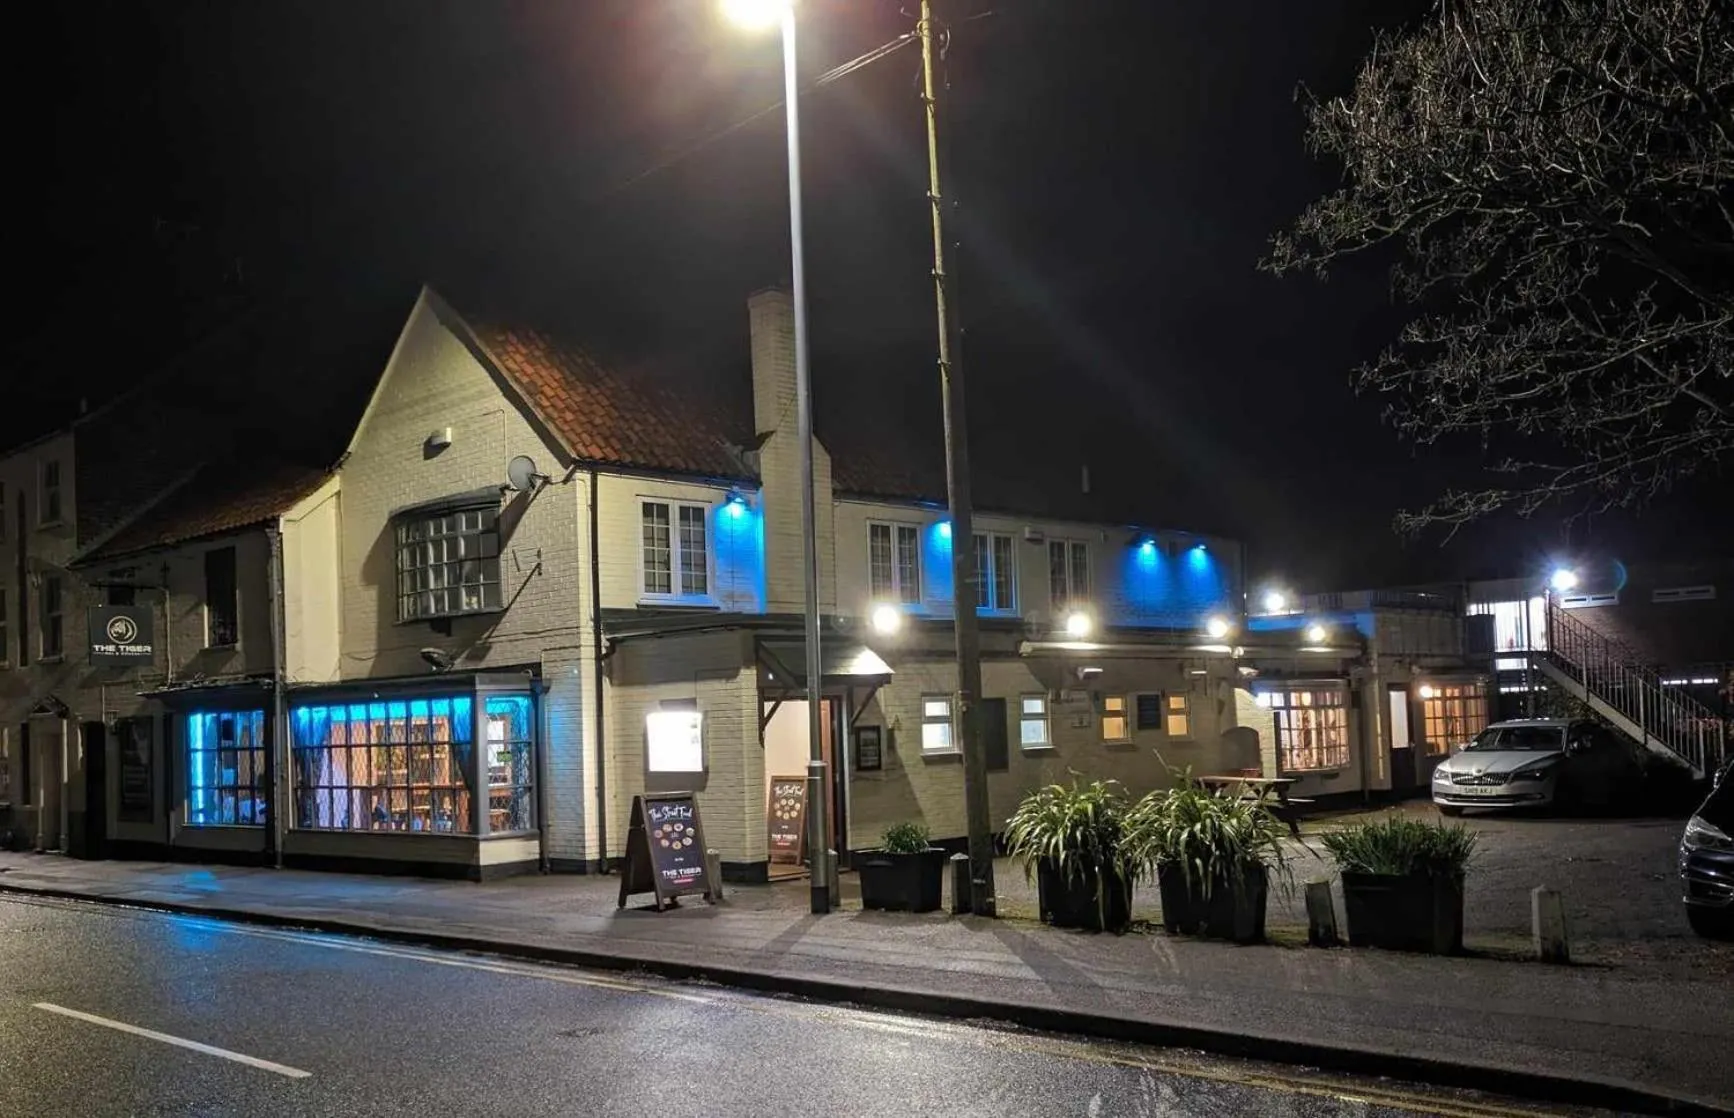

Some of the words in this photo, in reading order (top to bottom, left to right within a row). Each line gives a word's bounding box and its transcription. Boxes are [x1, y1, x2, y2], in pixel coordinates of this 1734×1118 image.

[93, 644, 116, 652] THE
[118, 645, 152, 653] TIGER
[661, 869, 677, 877] THE
[678, 866, 702, 875] TIGER
